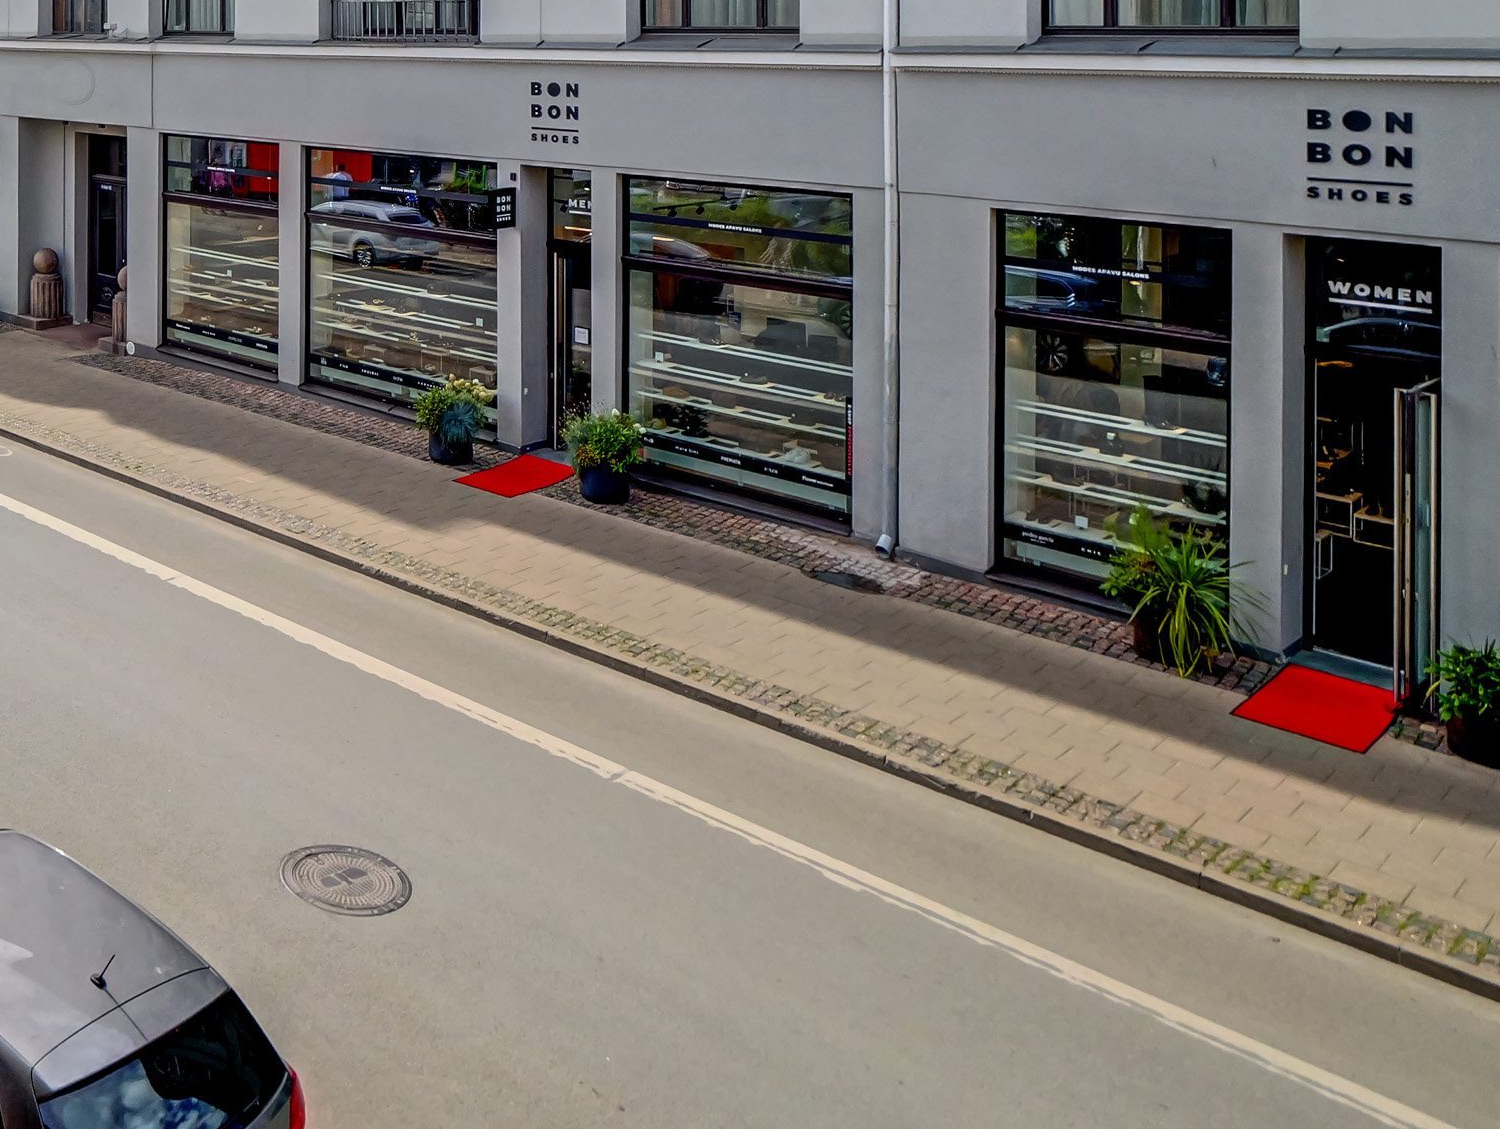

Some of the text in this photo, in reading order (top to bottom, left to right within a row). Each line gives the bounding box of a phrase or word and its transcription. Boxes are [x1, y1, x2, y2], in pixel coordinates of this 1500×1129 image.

[530, 82, 579, 98] BON
[530, 104, 579, 120] BON
[1307, 108, 1413, 134] BON
[531, 133, 579, 144] SHOES
[1307, 141, 1413, 169] BON
[496, 195, 511, 204] BON
[1306, 186, 1413, 206] SHOES
[496, 204, 511, 213] BON
[1072, 265, 1096, 273] MODES
[1097, 268, 1121, 276] APAVU
[1327, 280, 1433, 304] WOMEN
